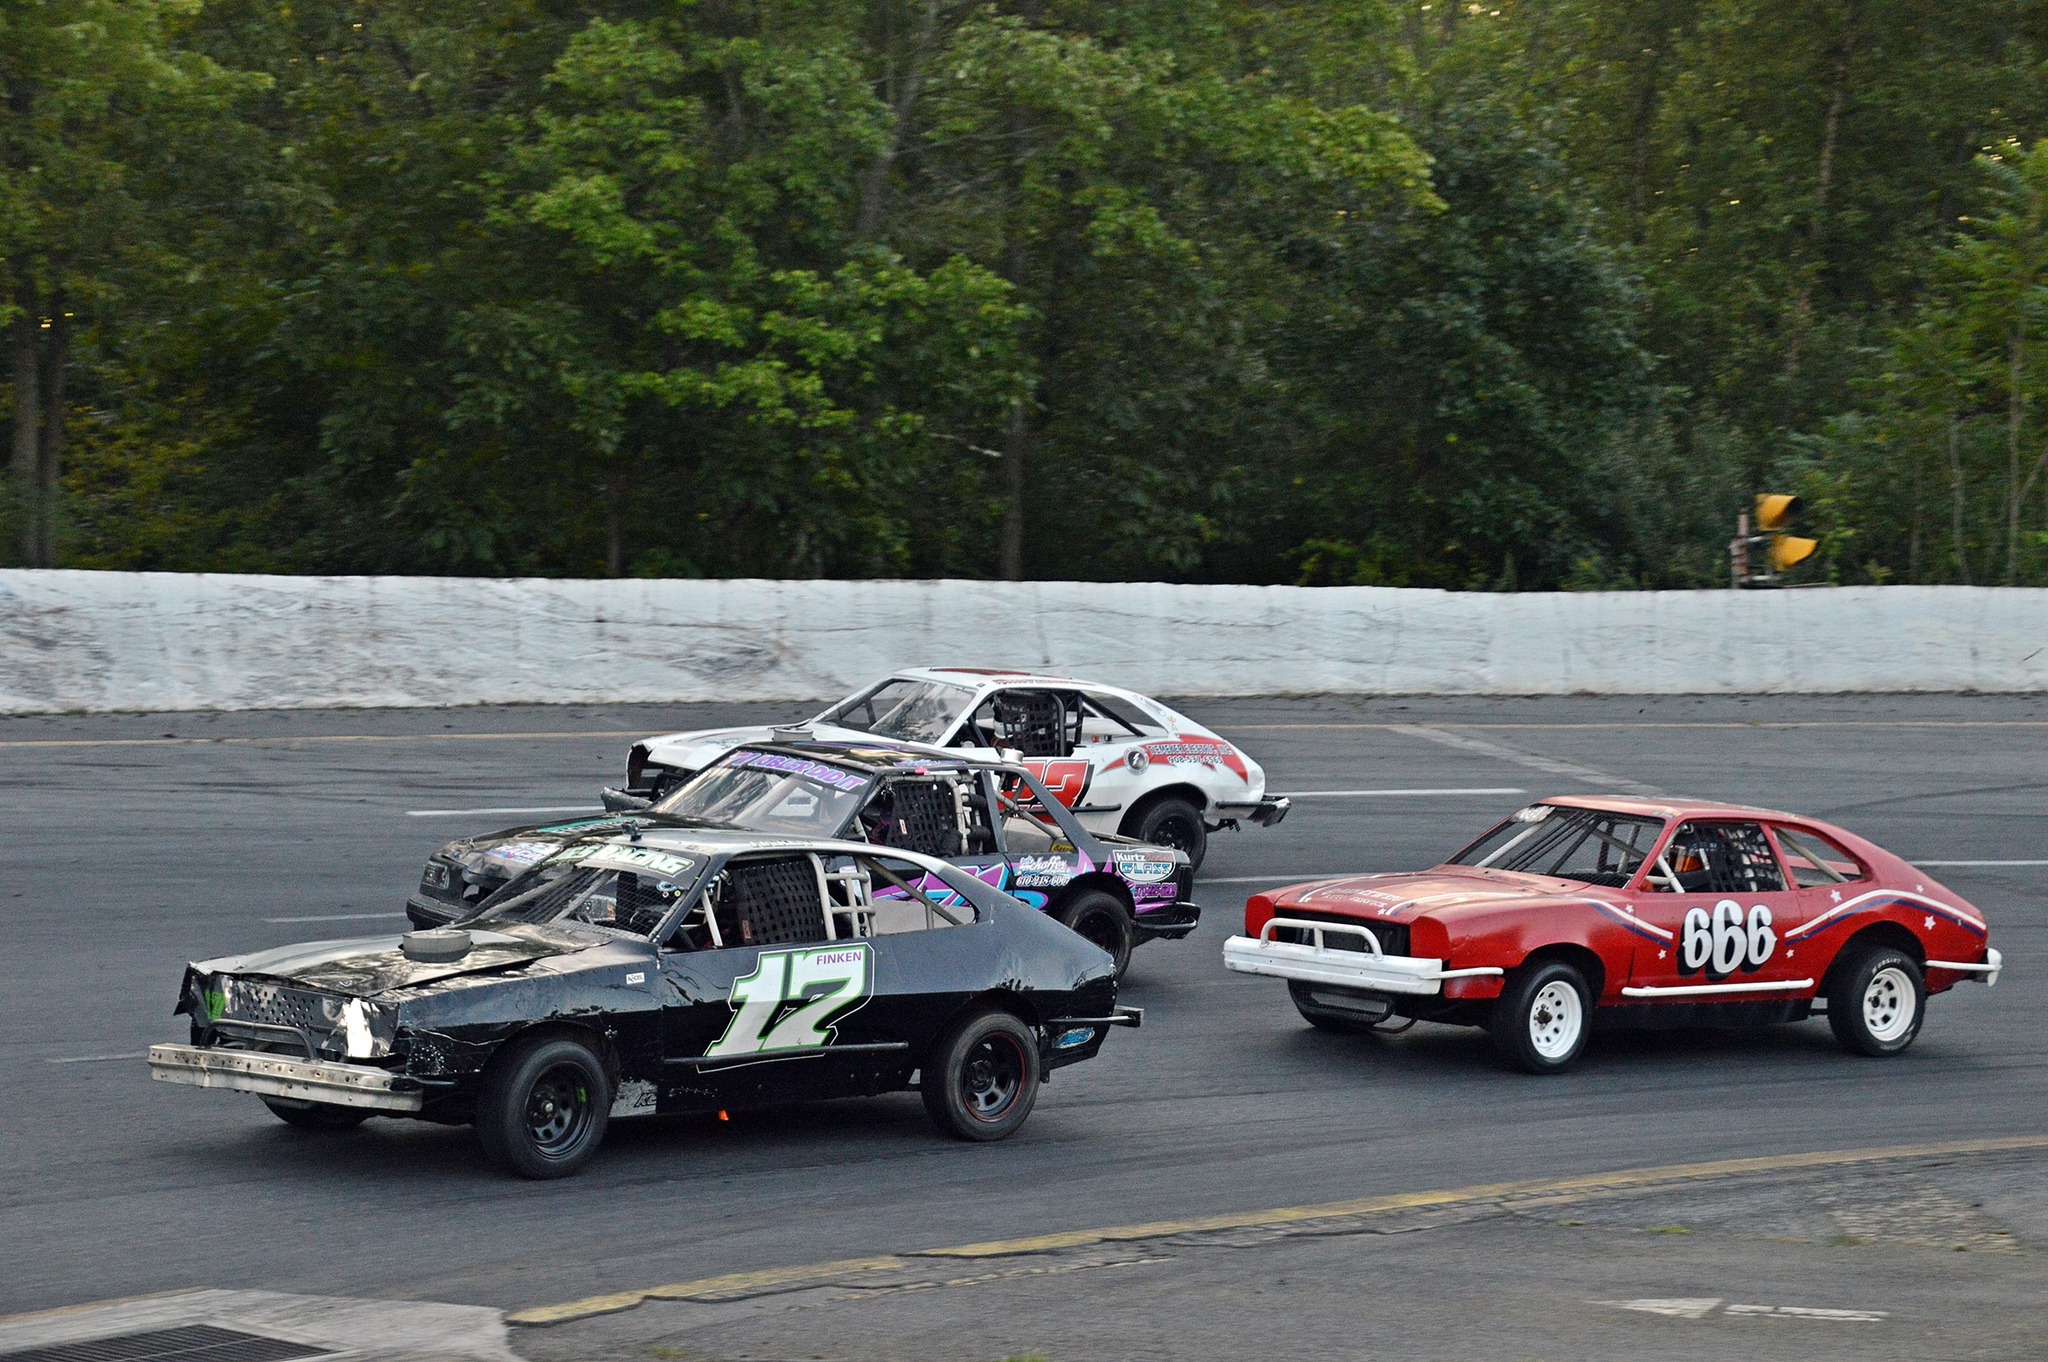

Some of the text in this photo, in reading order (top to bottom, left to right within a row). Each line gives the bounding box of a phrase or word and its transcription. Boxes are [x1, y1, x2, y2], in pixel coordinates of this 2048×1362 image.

[804, 765, 846, 783] DID
[834, 775, 868, 791] IT
[589, 845, 695, 877] RACING
[1116, 852, 1146, 862] Kurtz
[1121, 862, 1171, 875] GLASS
[1681, 898, 1778, 974] 666
[816, 951, 862, 966] FINKEN
[704, 945, 867, 1057] 17
